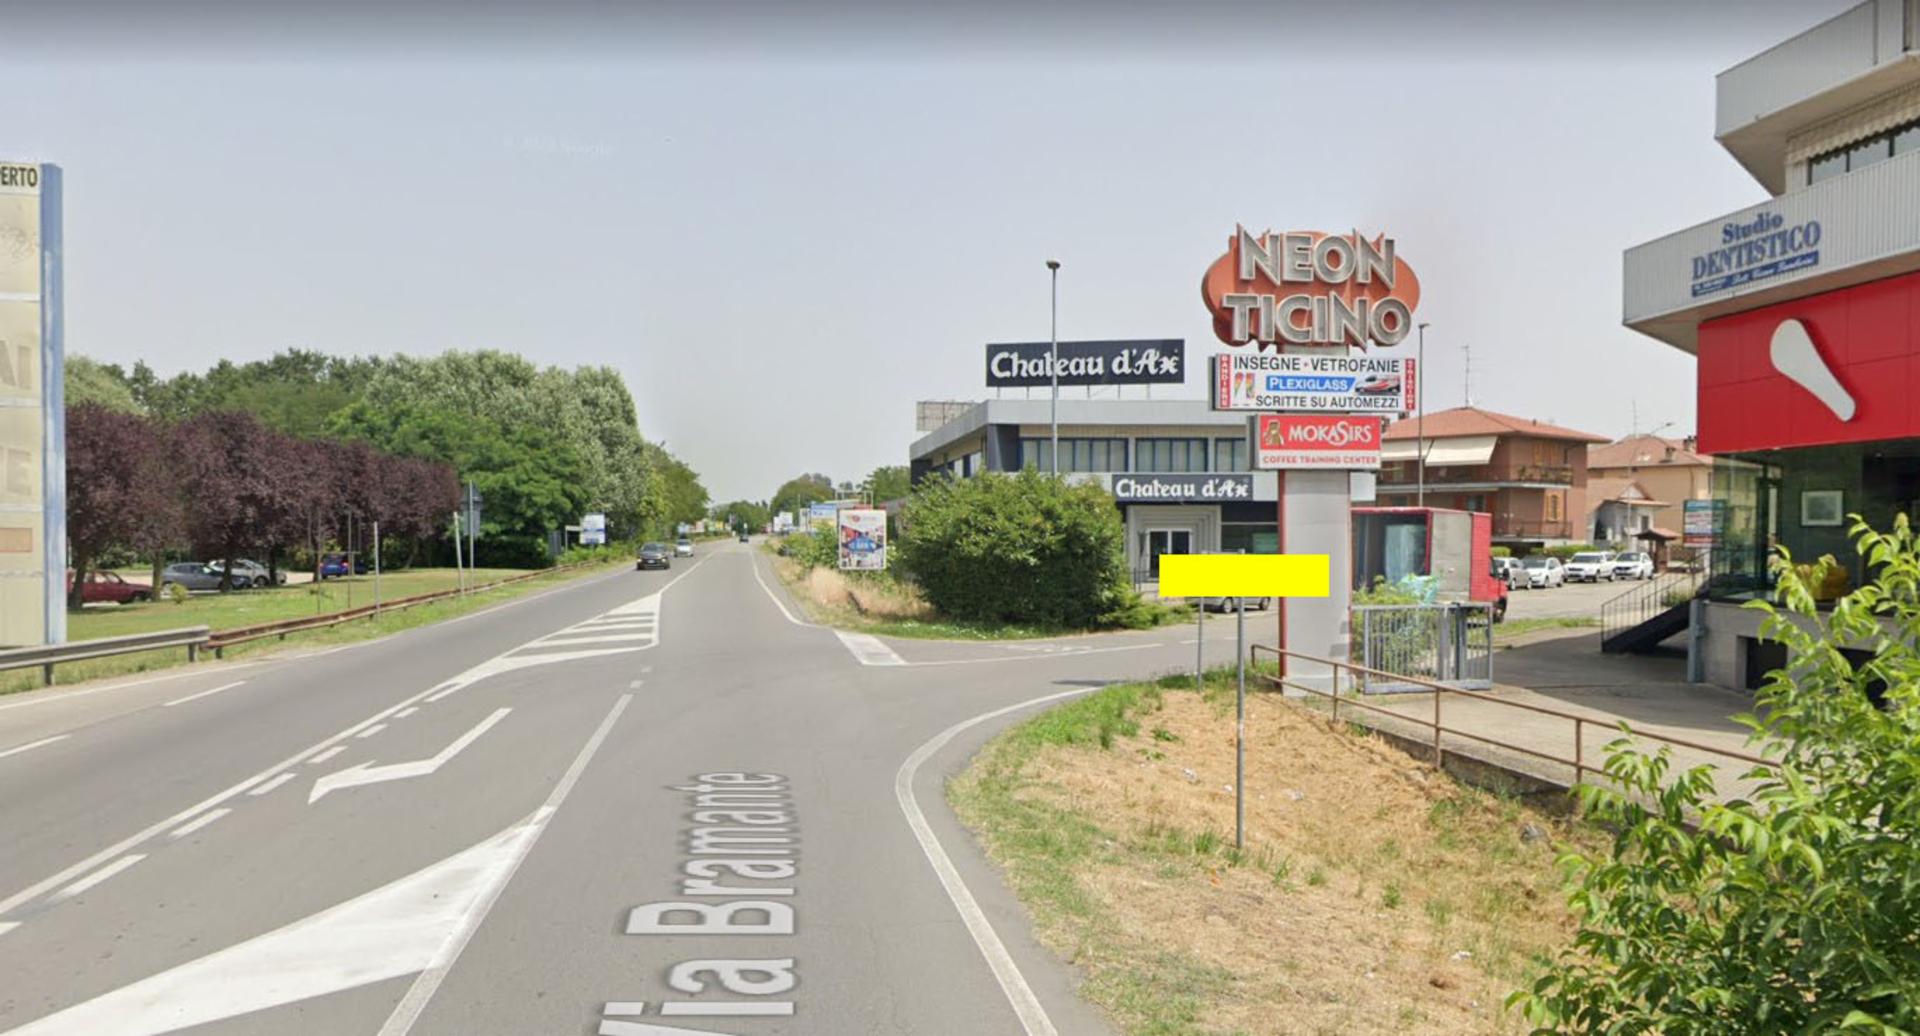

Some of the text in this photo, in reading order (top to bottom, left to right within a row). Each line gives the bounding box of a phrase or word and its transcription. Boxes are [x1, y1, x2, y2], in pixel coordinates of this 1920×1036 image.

[0, 166, 38, 187] ERTO
[1722, 212, 1784, 244] Studio
[1236, 223, 1396, 290] NEON
[1692, 220, 1821, 280] DENTISTICO
[1223, 290, 1411, 353] TICINO
[990, 350, 1104, 379] Chateau
[1234, 356, 1399, 373] INSEGNE VETROFANIE
[1269, 377, 1348, 391] PLEXIGLASS
[1256, 395, 1399, 409] SCRITTE SU AUTOMEZZI
[1263, 455, 1377, 464] COFFEE TRAINING CENTER
[1115, 478, 1195, 498] Chateau
